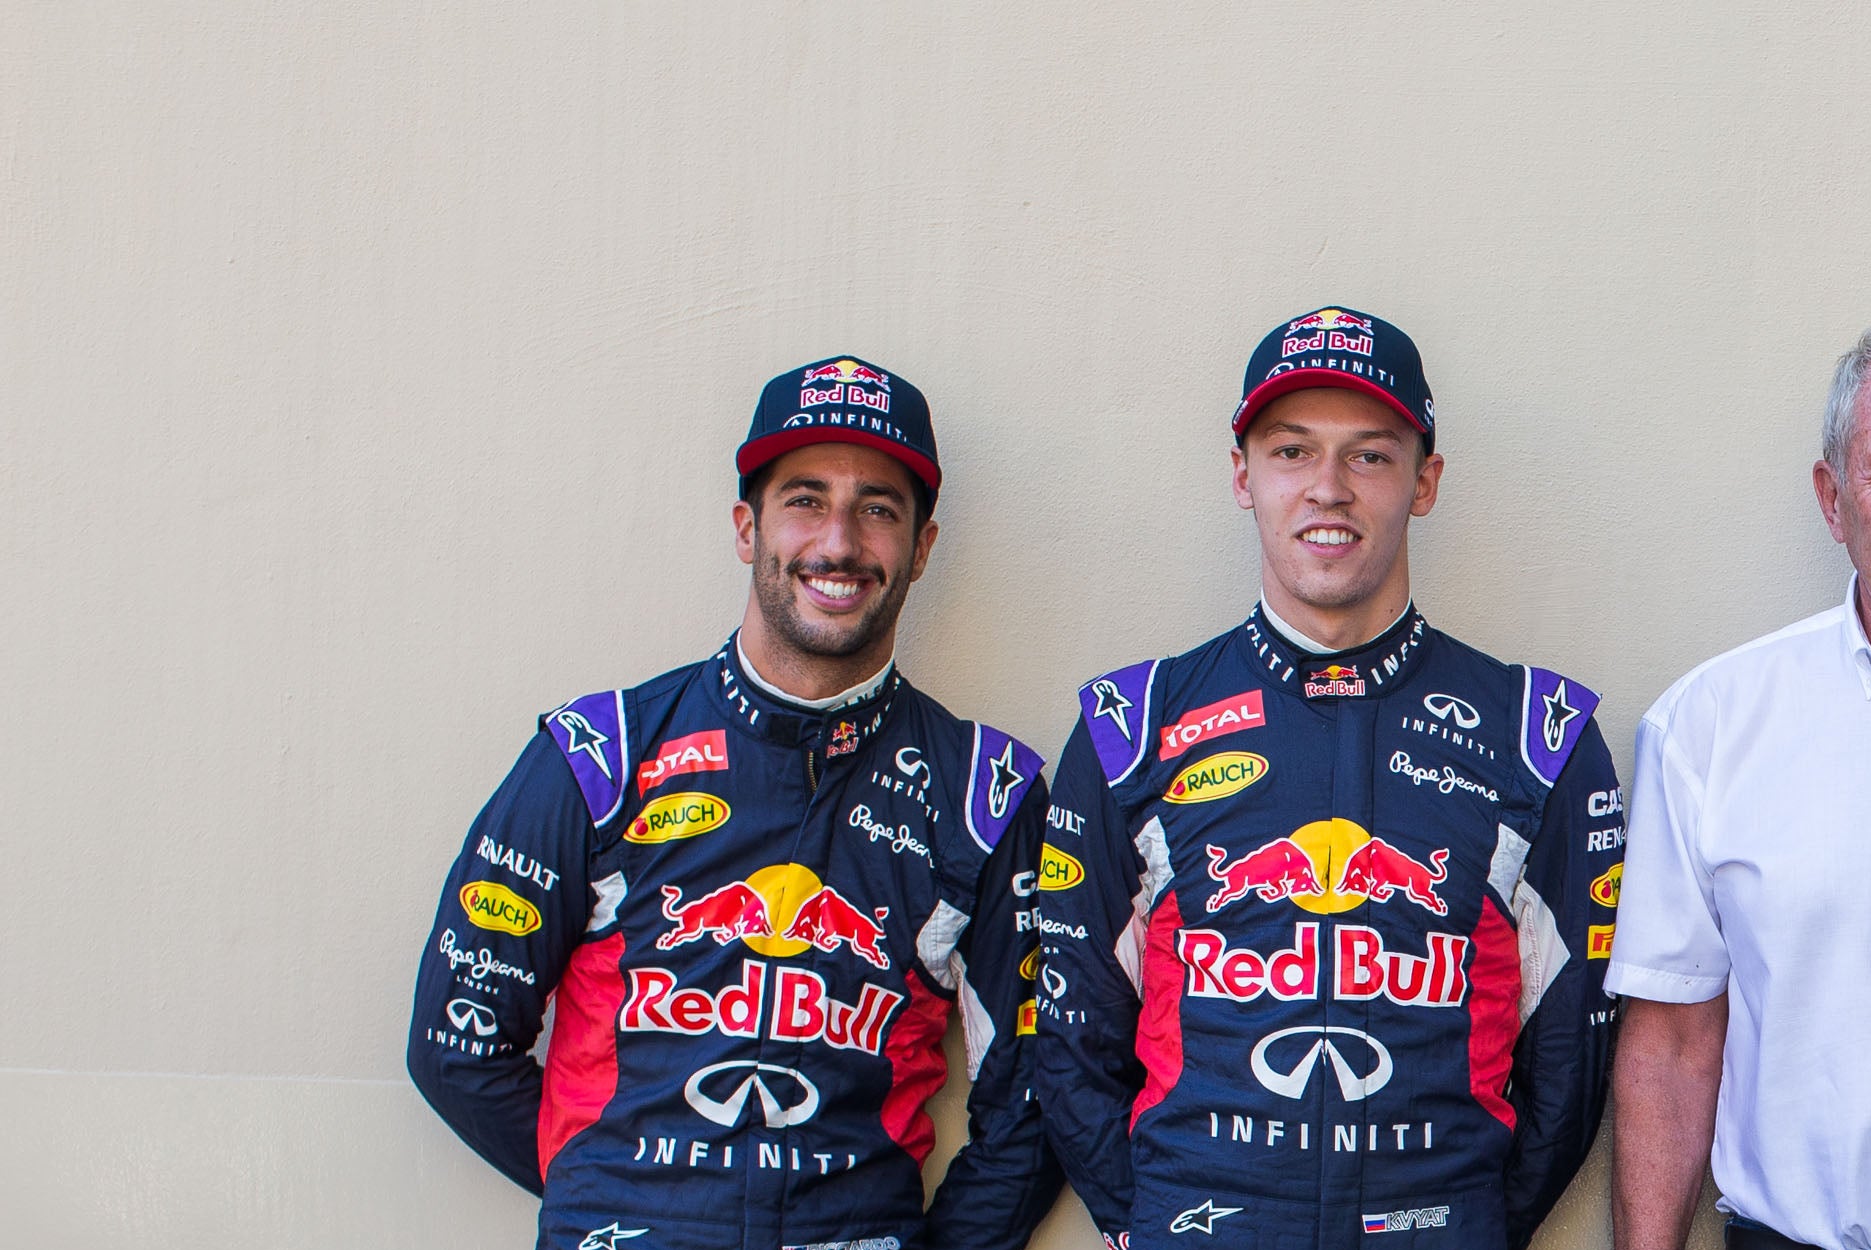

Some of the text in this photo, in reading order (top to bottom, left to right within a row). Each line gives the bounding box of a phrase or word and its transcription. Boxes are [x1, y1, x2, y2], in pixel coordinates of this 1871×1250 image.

[1282, 331, 1374, 358] Red Bull
[801, 384, 890, 413] Red Bull
[1305, 680, 1366, 698] Red Bull
[1166, 704, 1261, 748] TOTAL
[1401, 716, 1495, 761] INFINITI
[1187, 761, 1254, 792] RAUCH
[1389, 750, 1500, 802] Pepe Jeans
[650, 804, 715, 831] RAUCH
[471, 948, 536, 986] Jeans
[1178, 922, 1470, 1008] Red Bull
[620, 958, 904, 1057] Red Bull
[1210, 1111, 1433, 1152] INFINITI
[1386, 1206, 1450, 1232] KVYAT
